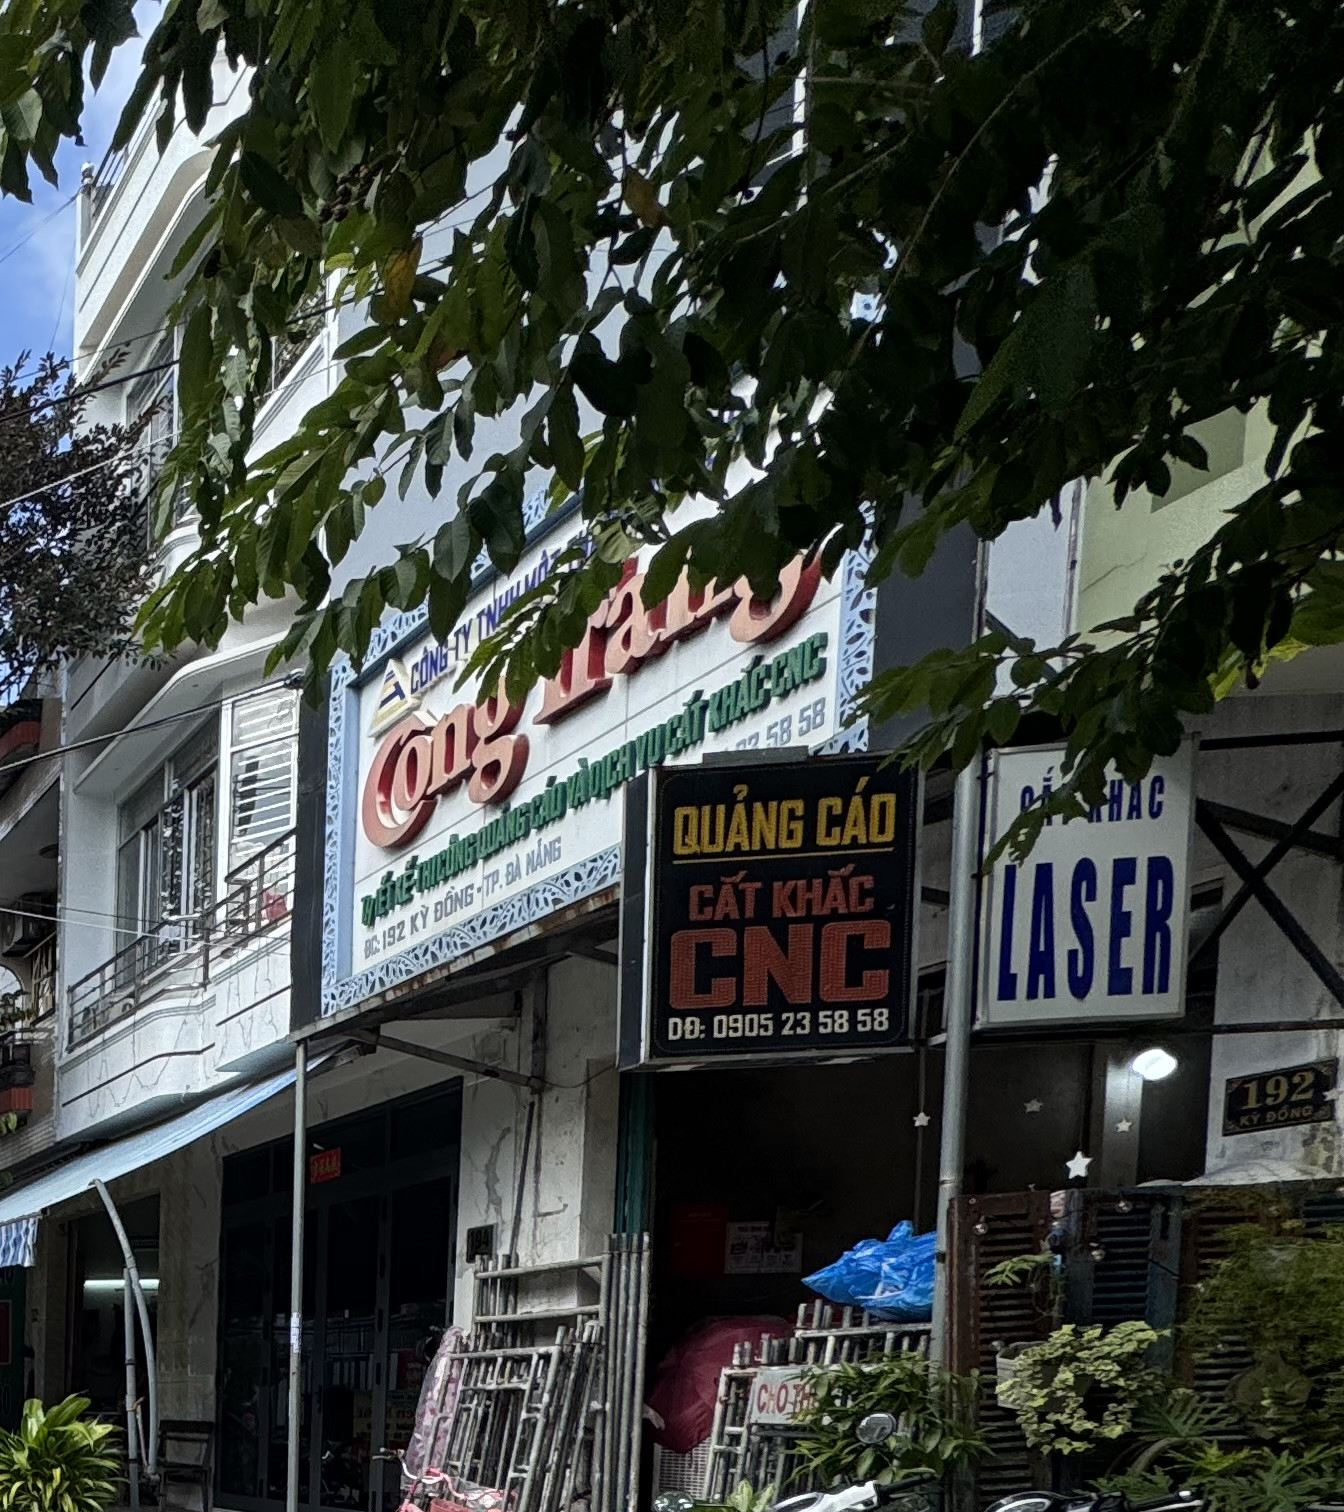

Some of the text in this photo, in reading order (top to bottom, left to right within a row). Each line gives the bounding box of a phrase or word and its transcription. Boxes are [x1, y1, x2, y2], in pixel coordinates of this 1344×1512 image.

[411, 645, 449, 695] CÔNG
[531, 776, 567, 830] CÁO
[708, 654, 772, 733] KHẮC
[771, 632, 828, 701] CNC
[766, 714, 792, 748] 58
[798, 697, 826, 737] 58
[672, 776, 898, 855] QUẢNG CÁO
[383, 919, 406, 950] 192
[409, 904, 430, 935] KỲ
[433, 883, 475, 923] ĐỒNG
[484, 868, 503, 896] TP.
[505, 854, 522, 886] ĐÀ
[689, 863, 875, 921] CẮT KHẮC
[997, 855, 1173, 1001] LASER
[668, 919, 891, 1010] CNC
[712, 1013, 773, 1039] 0905
[780, 1011, 812, 1036] 23
[818, 1009, 850, 1034] 58
[856, 1007, 890, 1032] 58
[1240, 1070, 1316, 1110] 192
